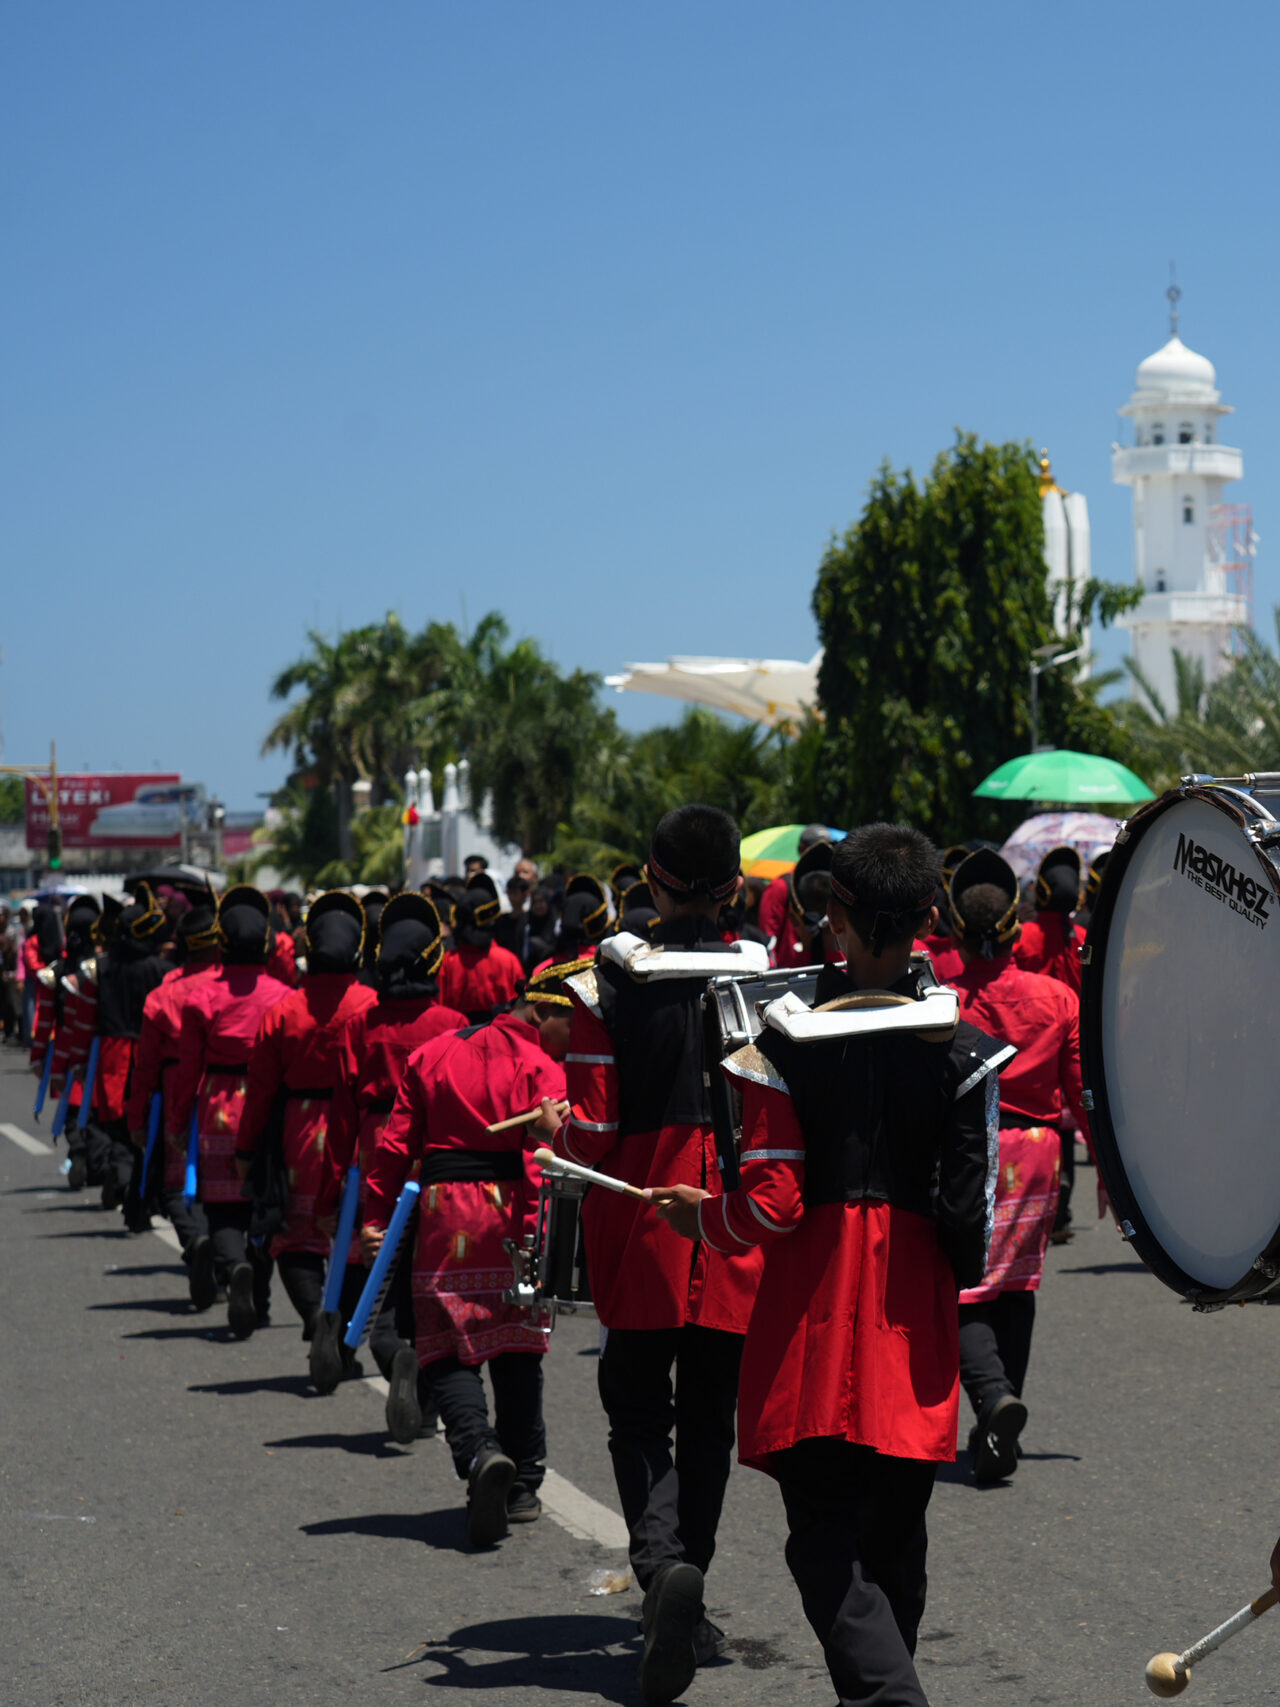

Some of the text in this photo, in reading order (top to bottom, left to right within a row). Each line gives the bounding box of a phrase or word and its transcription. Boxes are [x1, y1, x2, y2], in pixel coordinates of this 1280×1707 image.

[1186, 869, 1267, 930] THE BEST QUALITY
